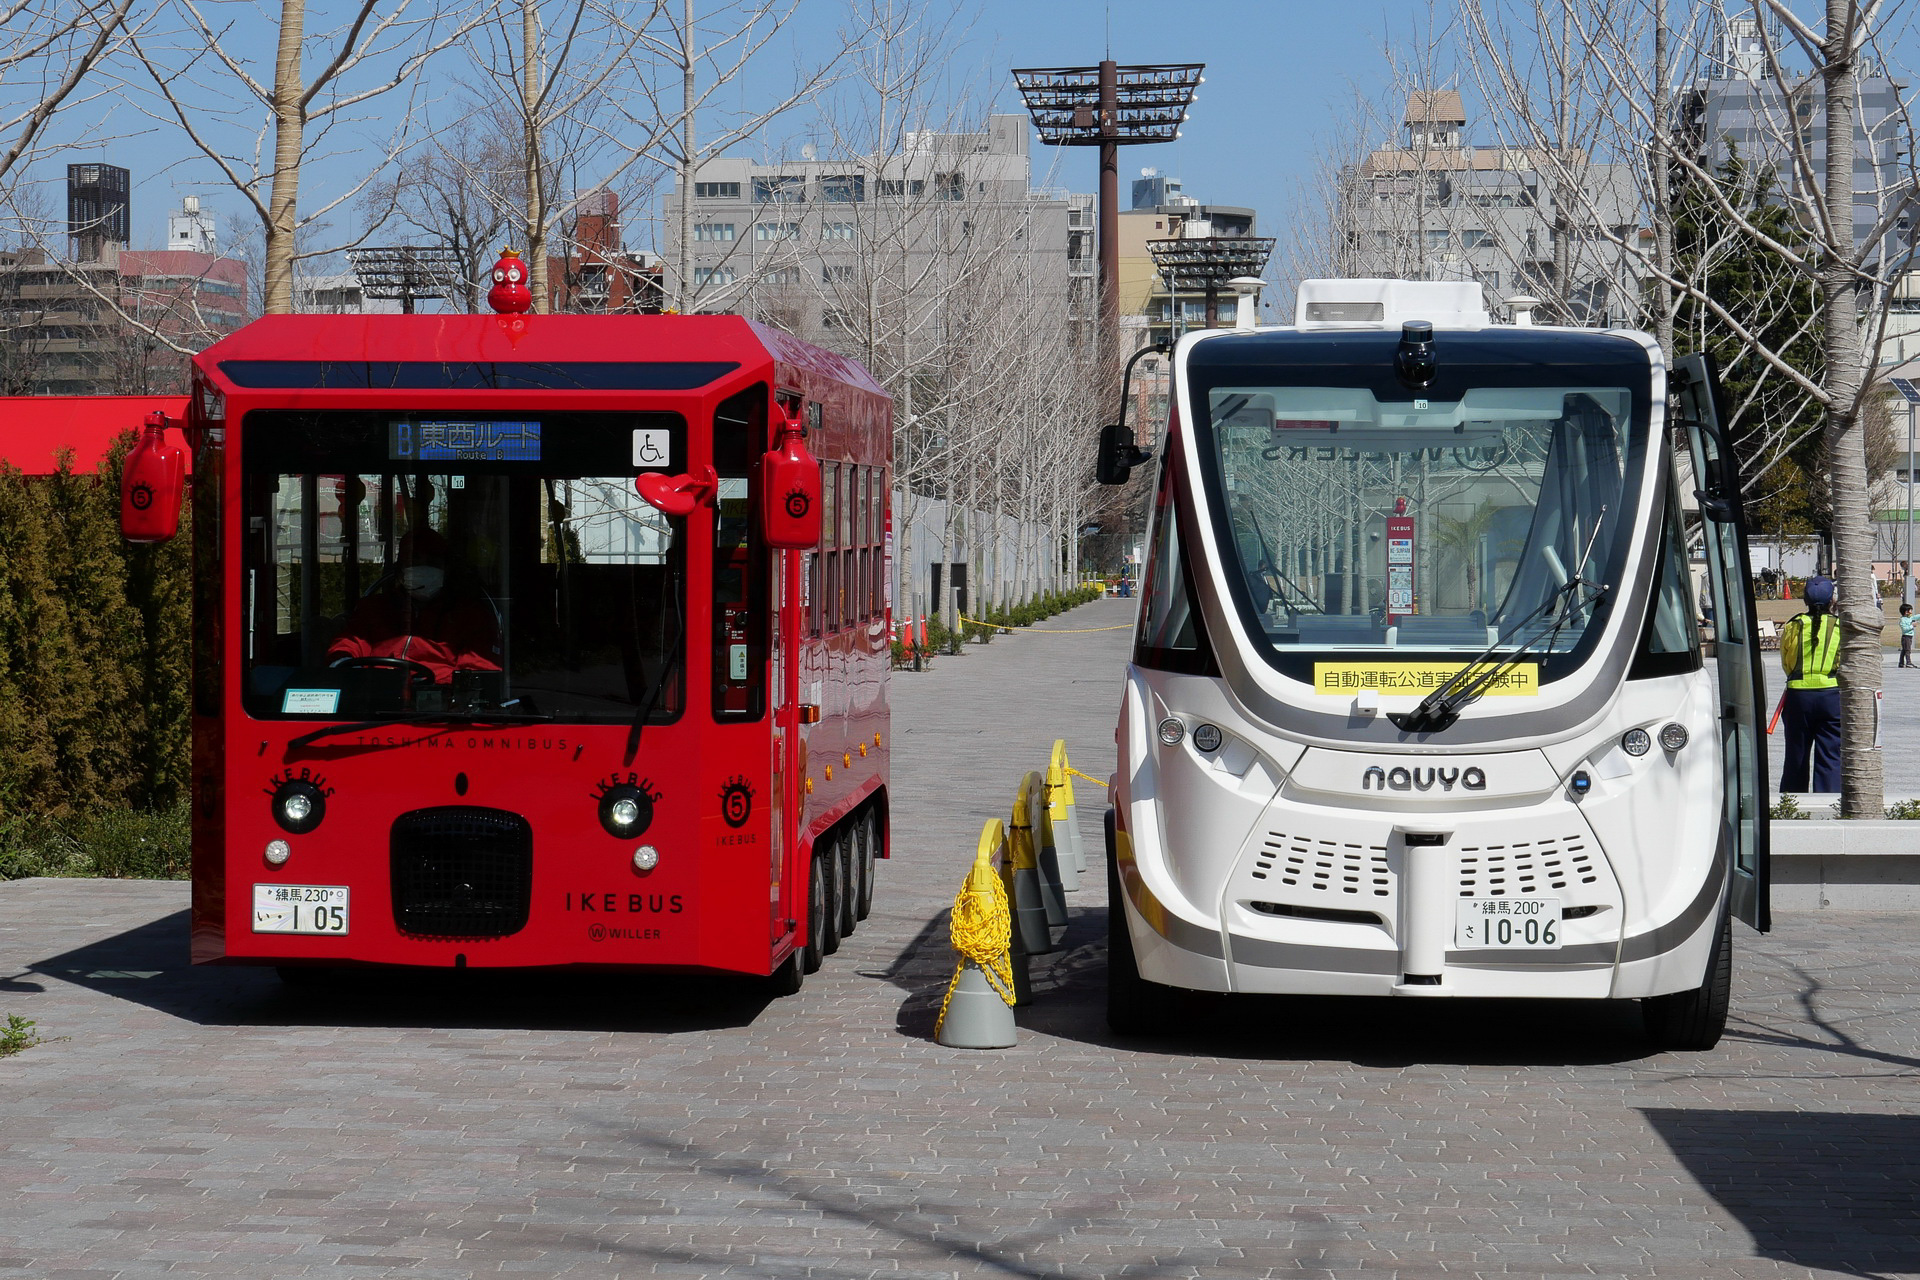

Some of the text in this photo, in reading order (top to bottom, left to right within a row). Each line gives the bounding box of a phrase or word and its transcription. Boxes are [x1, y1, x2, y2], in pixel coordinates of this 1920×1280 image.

[420, 422, 540, 449] 東西ルート
[456, 449, 504, 460] Route B
[357, 737, 567, 750] TOSHIMA OMNIBUS
[731, 795, 743, 818] 5
[275, 888, 329, 903] 練馬 230
[1482, 901, 1539, 915] 練馬 200
[609, 928, 661, 939] WILLER
[1484, 918, 1557, 945] 10-06
